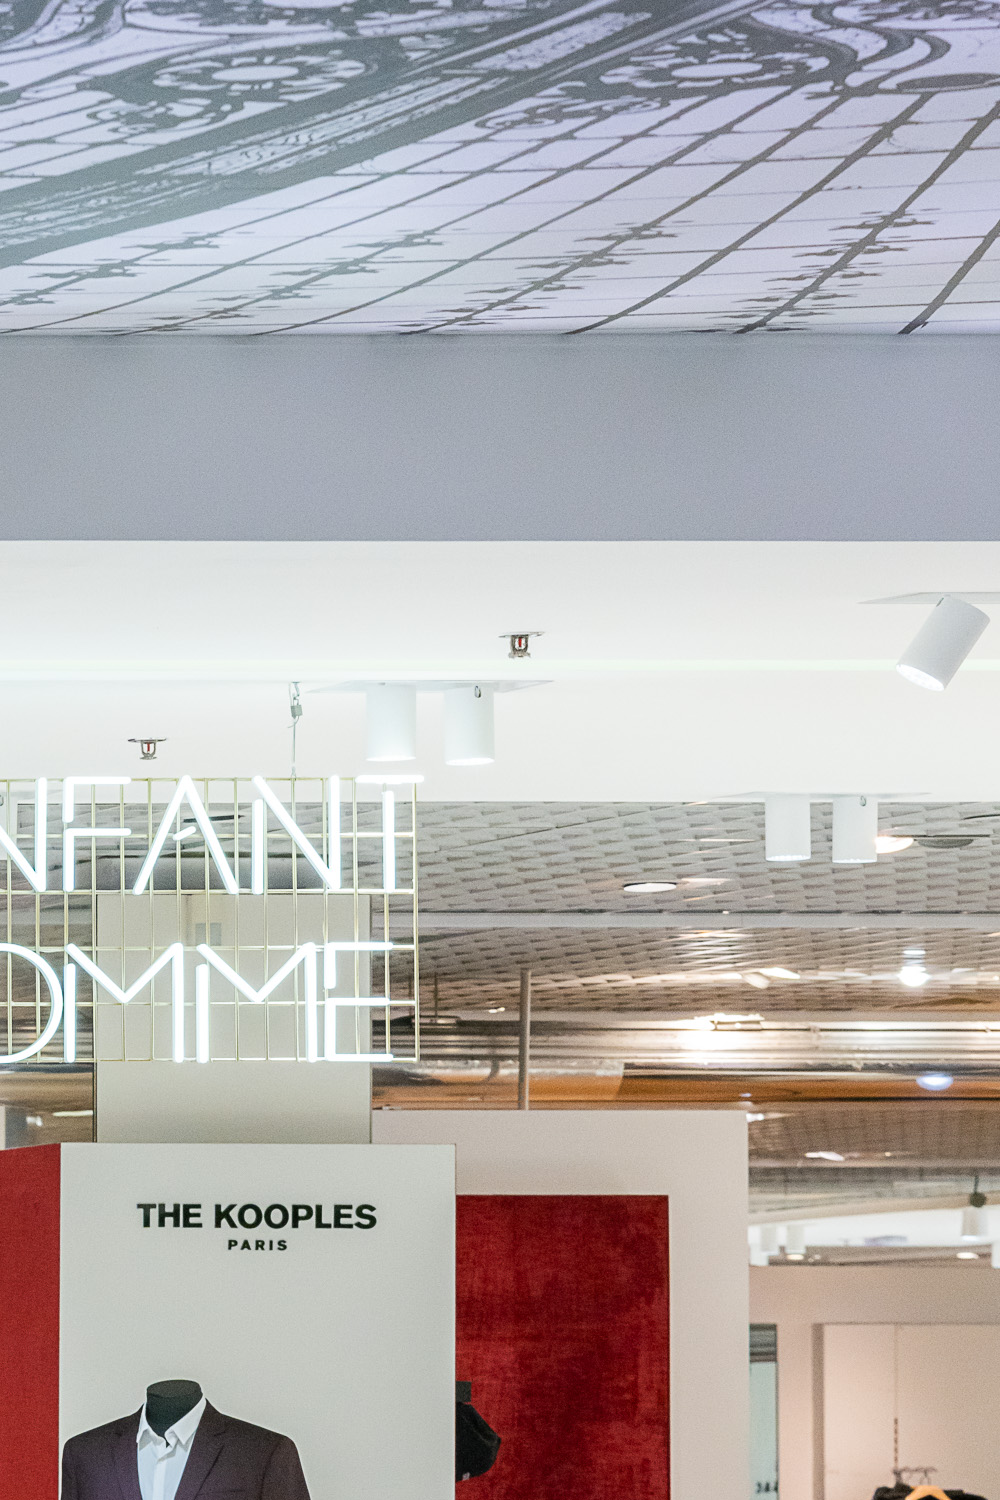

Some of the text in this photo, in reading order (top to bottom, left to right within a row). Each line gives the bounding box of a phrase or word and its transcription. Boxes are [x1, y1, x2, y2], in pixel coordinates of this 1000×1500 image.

[137, 1203, 378, 1230] THE KOOPLES
[228, 1240, 288, 1252] PARIS
